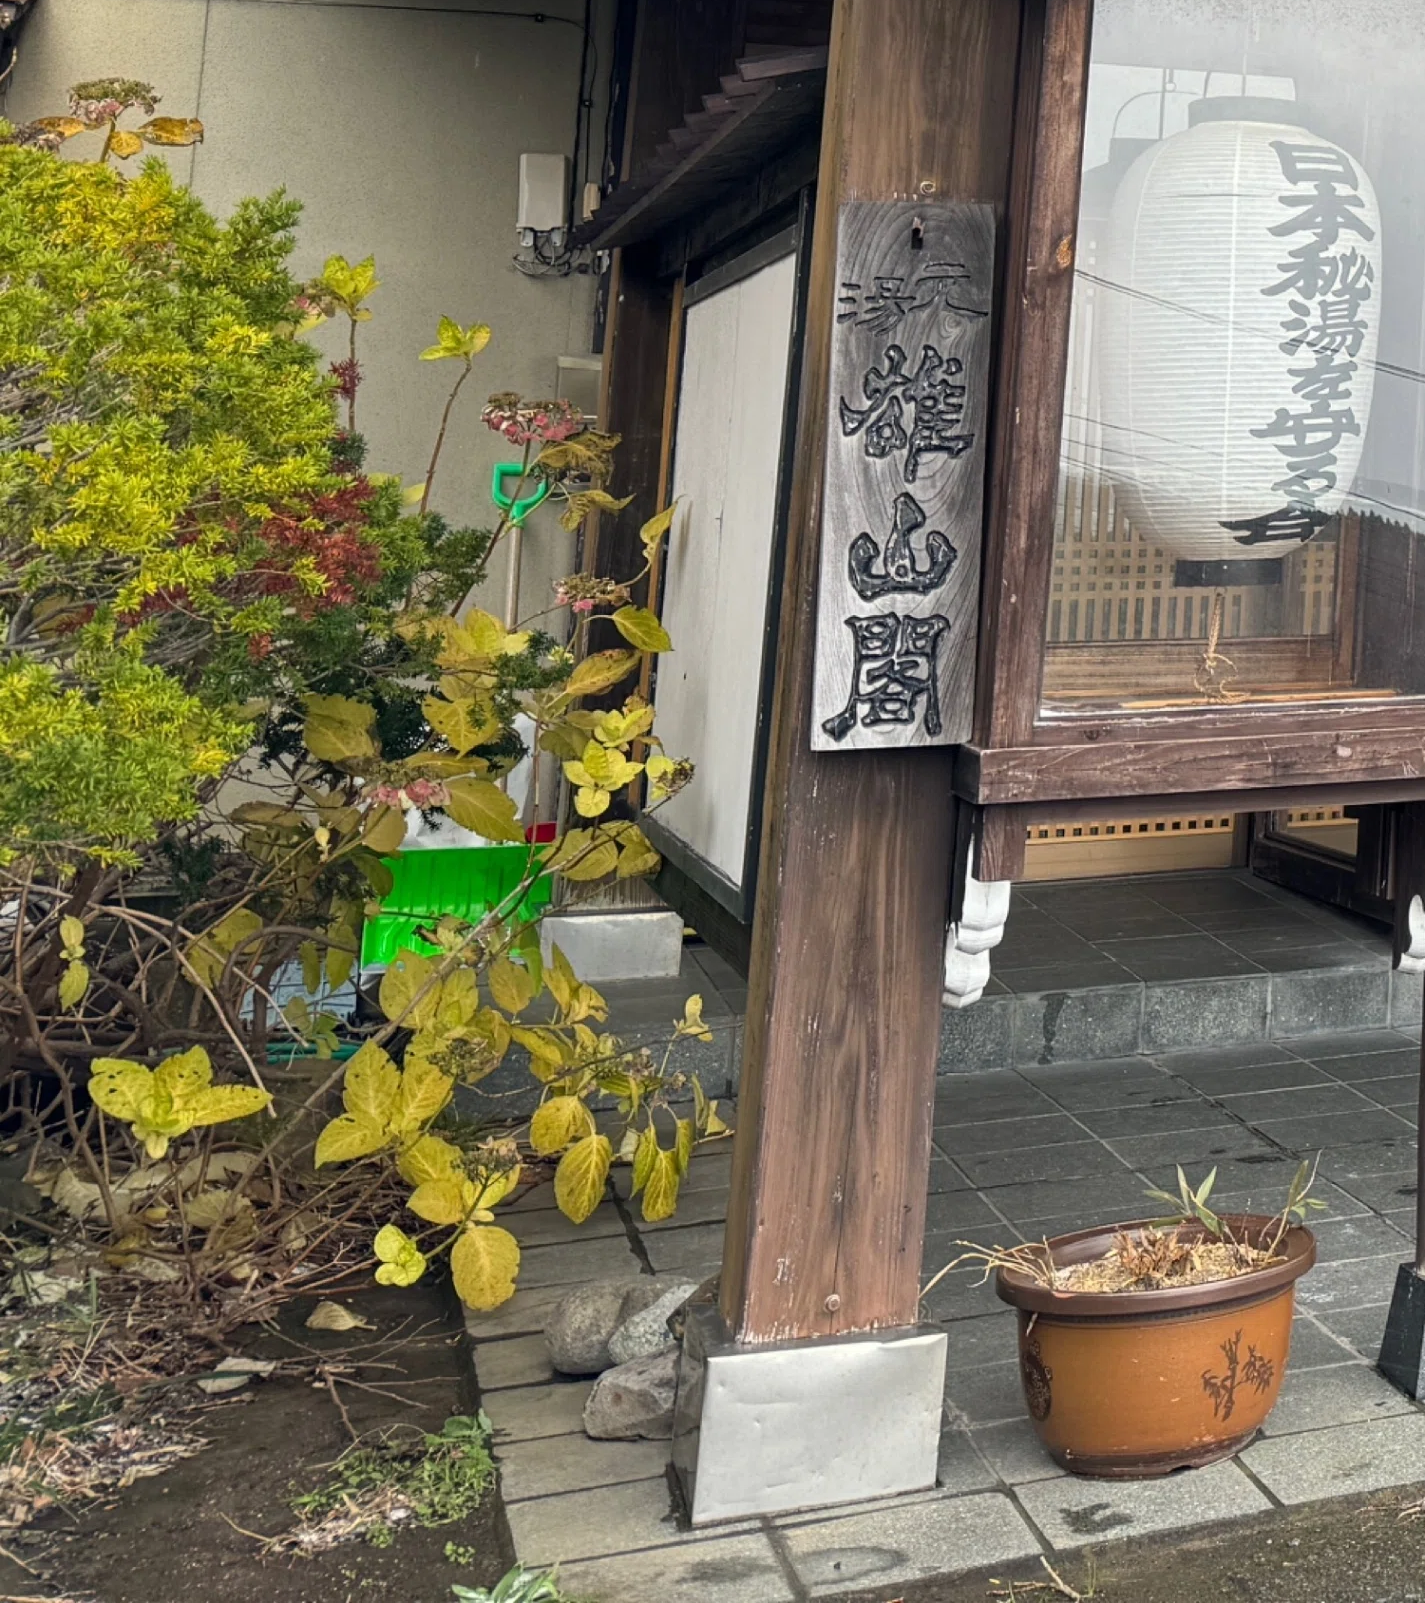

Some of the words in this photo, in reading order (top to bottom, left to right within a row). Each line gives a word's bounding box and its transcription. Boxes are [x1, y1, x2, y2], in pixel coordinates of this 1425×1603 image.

[822, 343, 976, 742] 雄山閣
[1217, 140, 1376, 546] 日本秘湯を守る会
